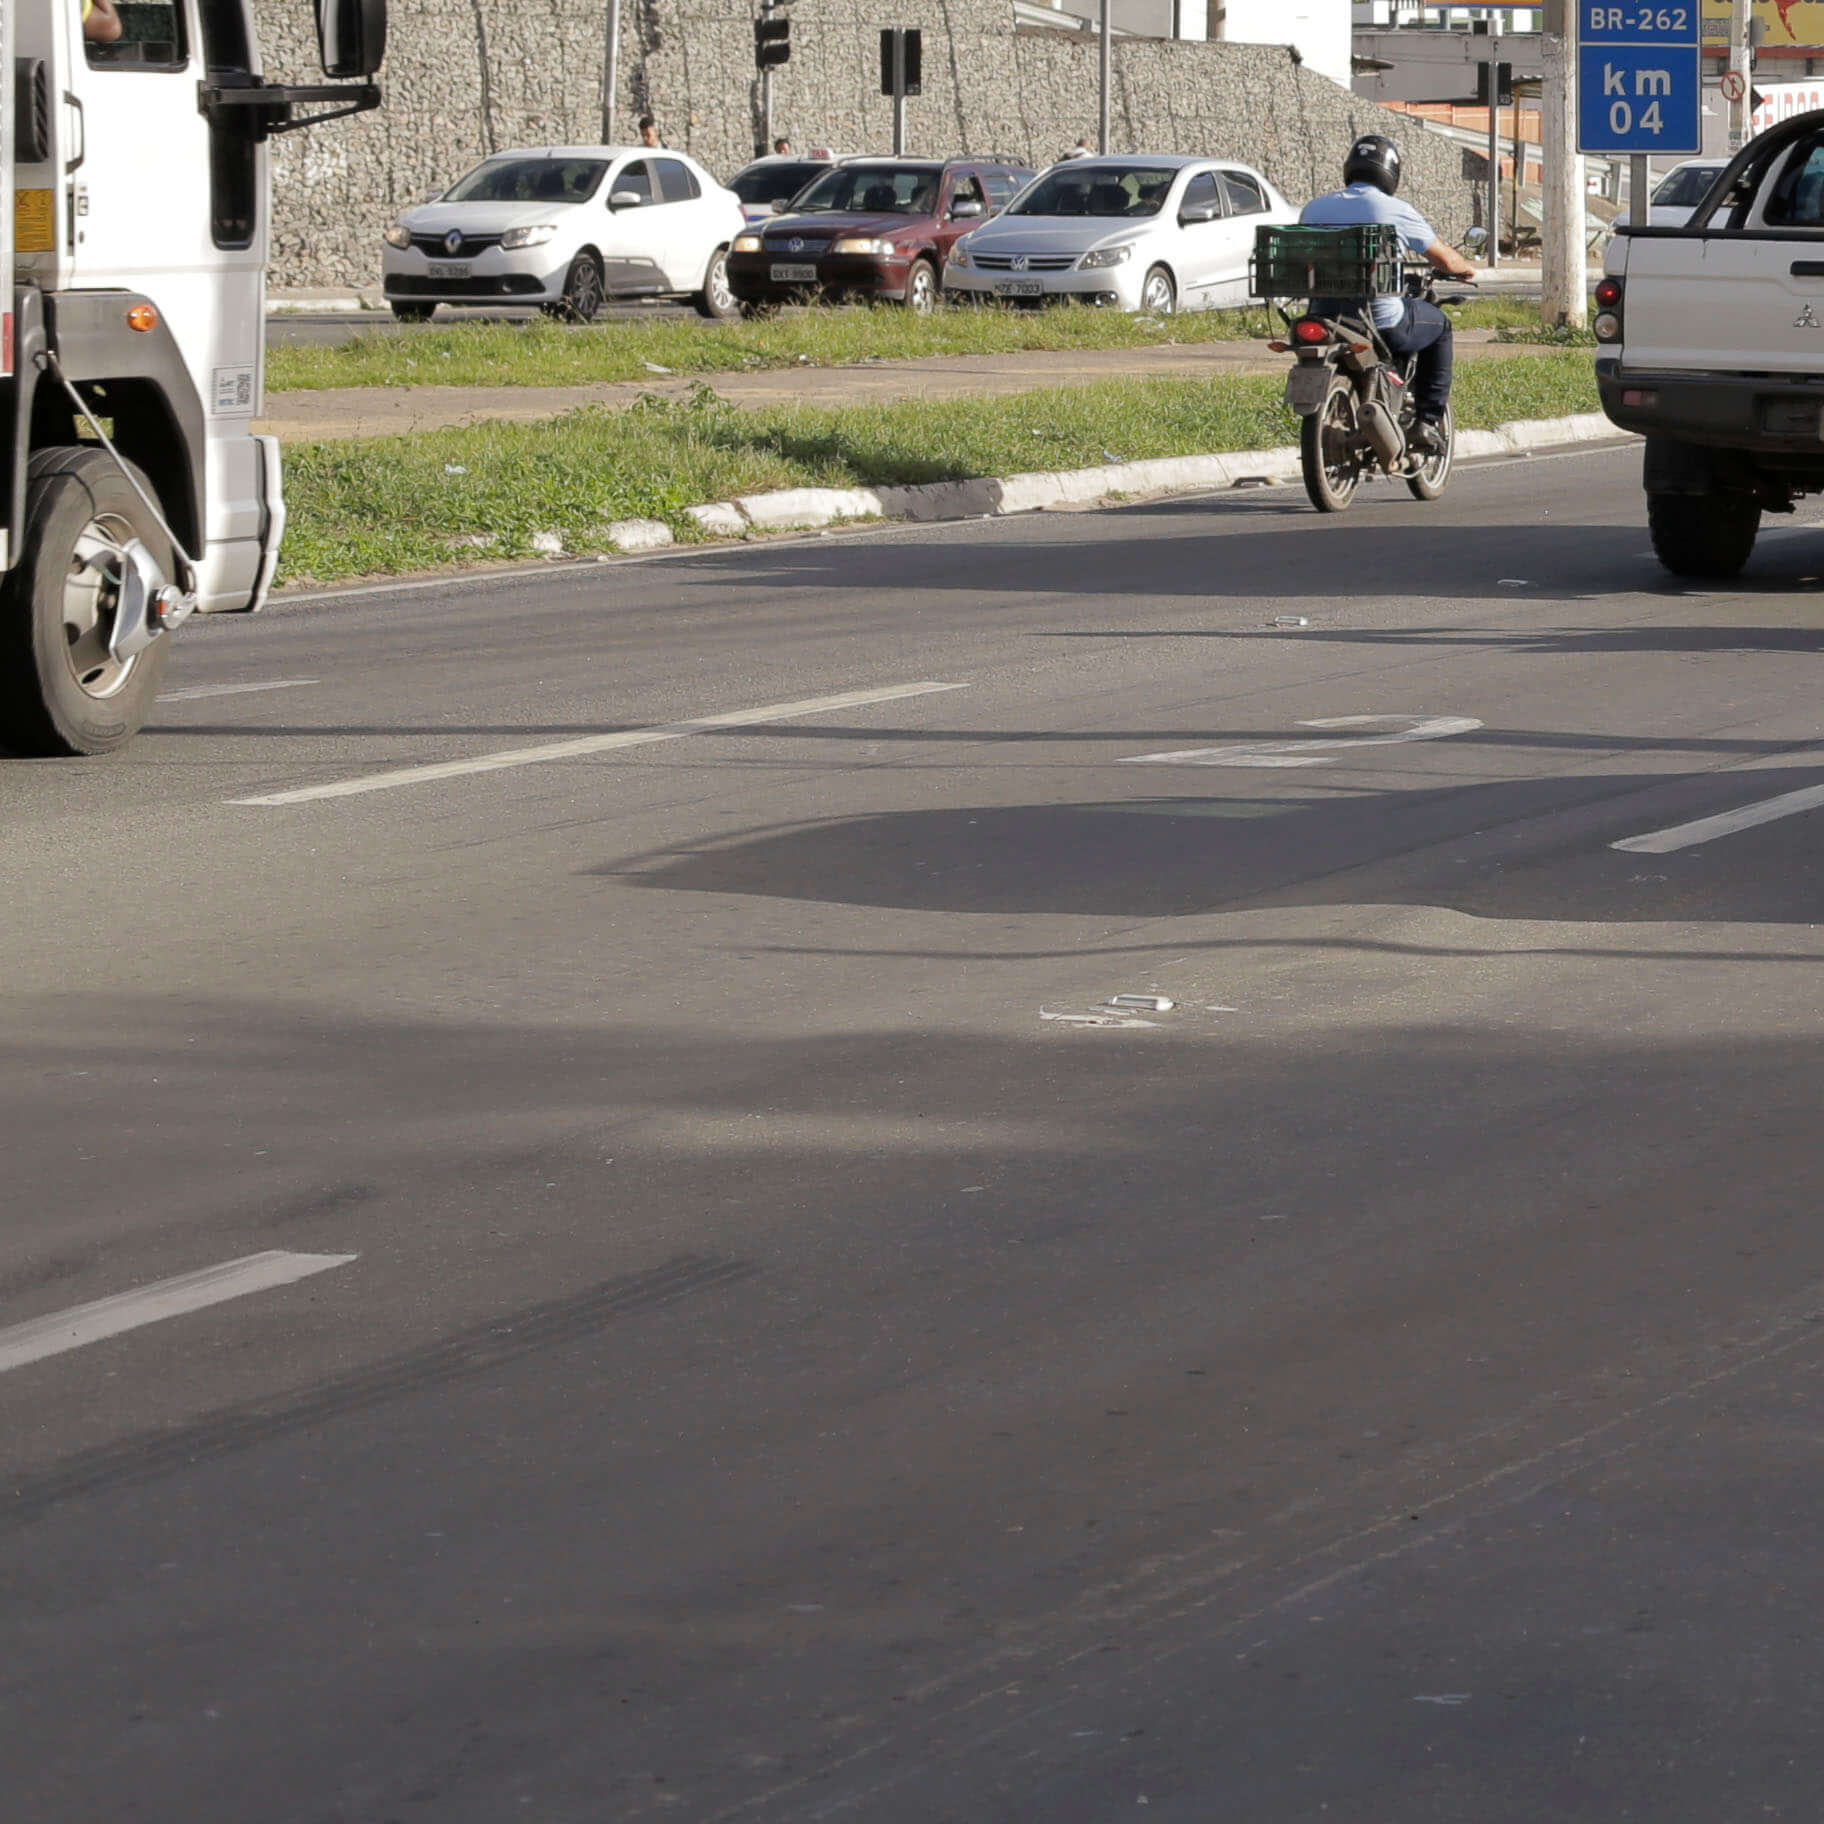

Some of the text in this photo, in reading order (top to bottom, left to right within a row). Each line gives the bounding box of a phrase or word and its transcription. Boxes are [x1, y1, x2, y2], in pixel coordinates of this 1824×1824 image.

[1590, 7, 1688, 31] BR-262
[1603, 61, 1672, 97] km
[1609, 100, 1664, 135] 04
